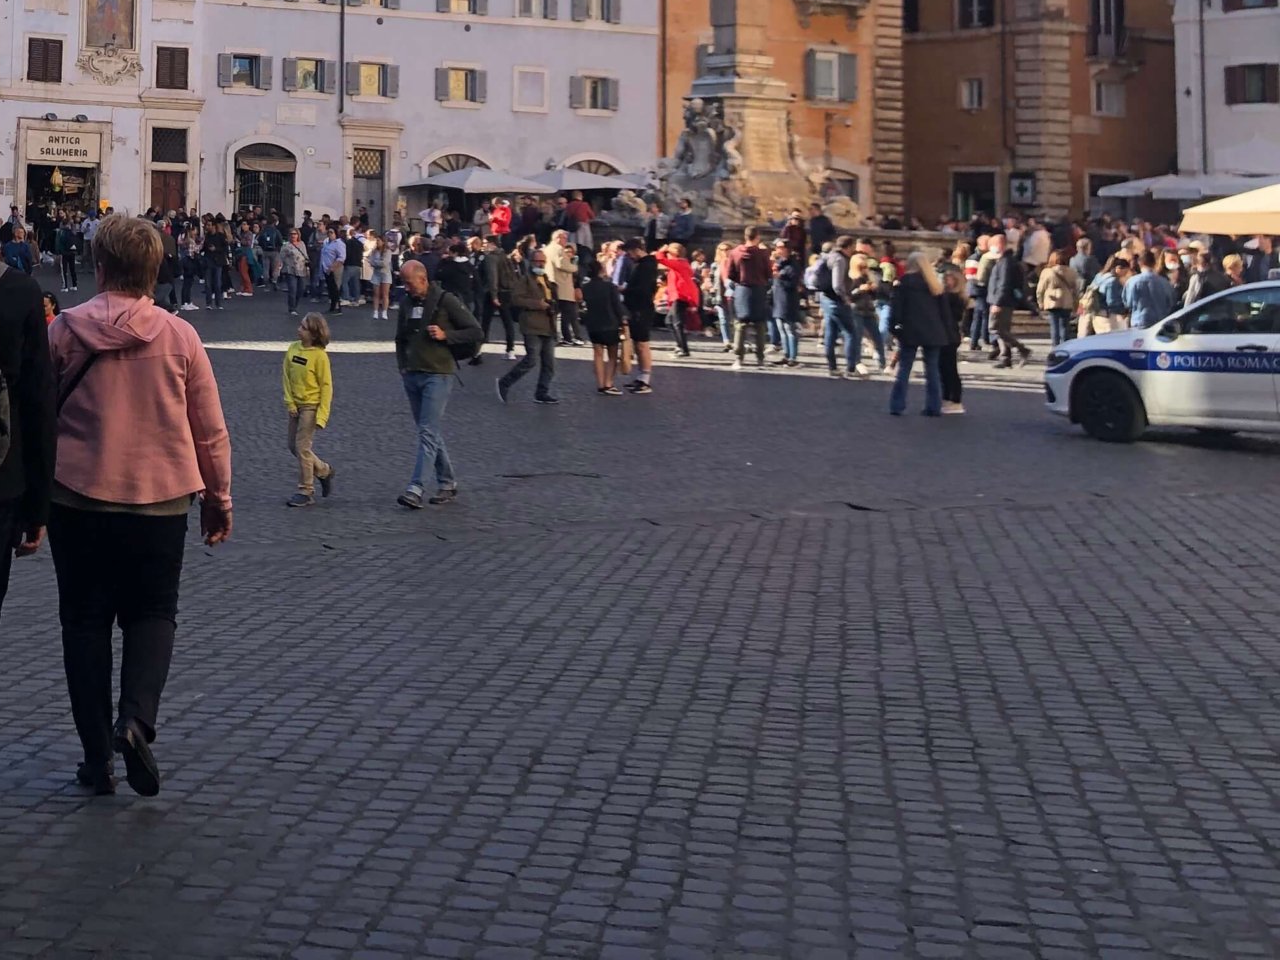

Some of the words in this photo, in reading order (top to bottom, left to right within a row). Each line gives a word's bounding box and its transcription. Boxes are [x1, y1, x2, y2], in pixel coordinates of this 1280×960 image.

[48, 135, 81, 145] ANTICA
[40, 147, 88, 157] SALUMERIA
[1173, 354, 1224, 368] POLIZIA
[1227, 356, 1270, 369] ROMA
